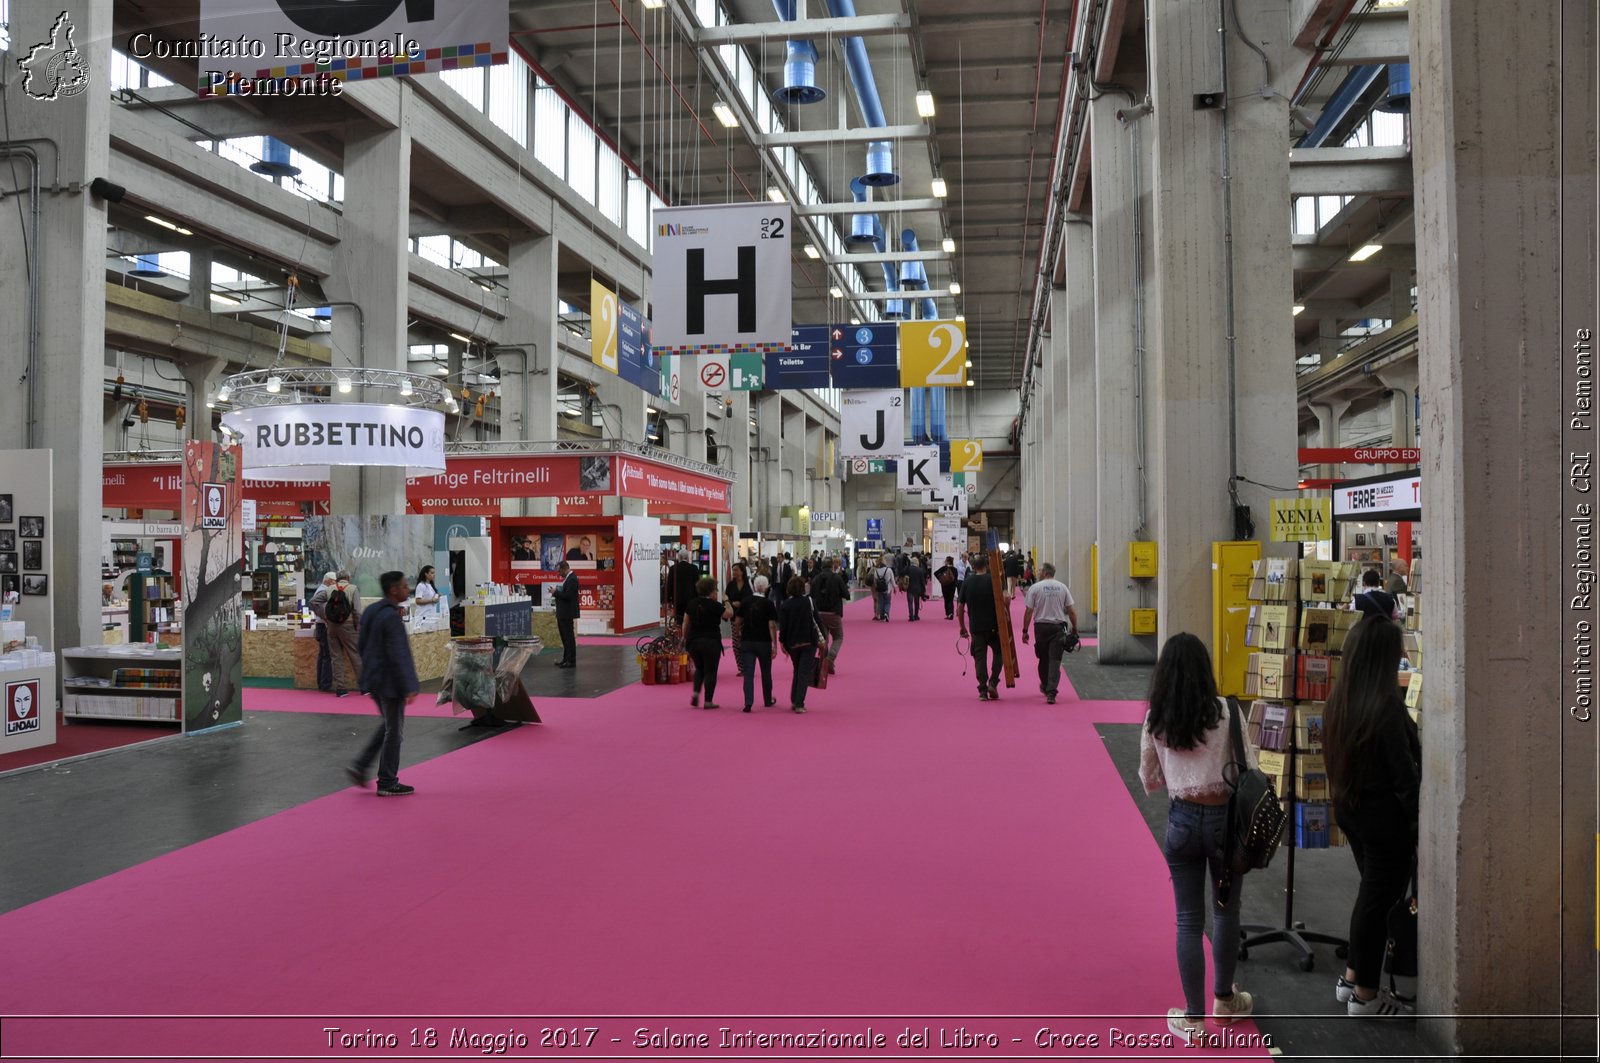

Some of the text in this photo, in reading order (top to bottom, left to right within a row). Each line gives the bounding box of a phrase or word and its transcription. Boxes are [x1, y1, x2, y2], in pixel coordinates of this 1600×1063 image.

[761, 218, 769, 239] PAD
[770, 218, 784, 239] 2
[686, 246, 756, 335] H
[602, 294, 617, 370] 2
[860, 329, 869, 343] 3
[860, 349, 869, 362] 5
[926, 323, 964, 384] 2
[894, 396, 901, 407] 2
[860, 410, 885, 451] J
[963, 441, 982, 471] 2
[1354, 451, 1399, 460] GRUPPO
[474, 467, 550, 485] Feltrinelli
[908, 459, 931, 486] K
[422, 497, 448, 507] sono
[1347, 488, 1376, 510] TERRE
[1277, 510, 1323, 524] XENIA
[156, 524, 172, 533] barra
[352, 546, 384, 558] Oltre
[634, 542, 660, 561] Feltrinelli
